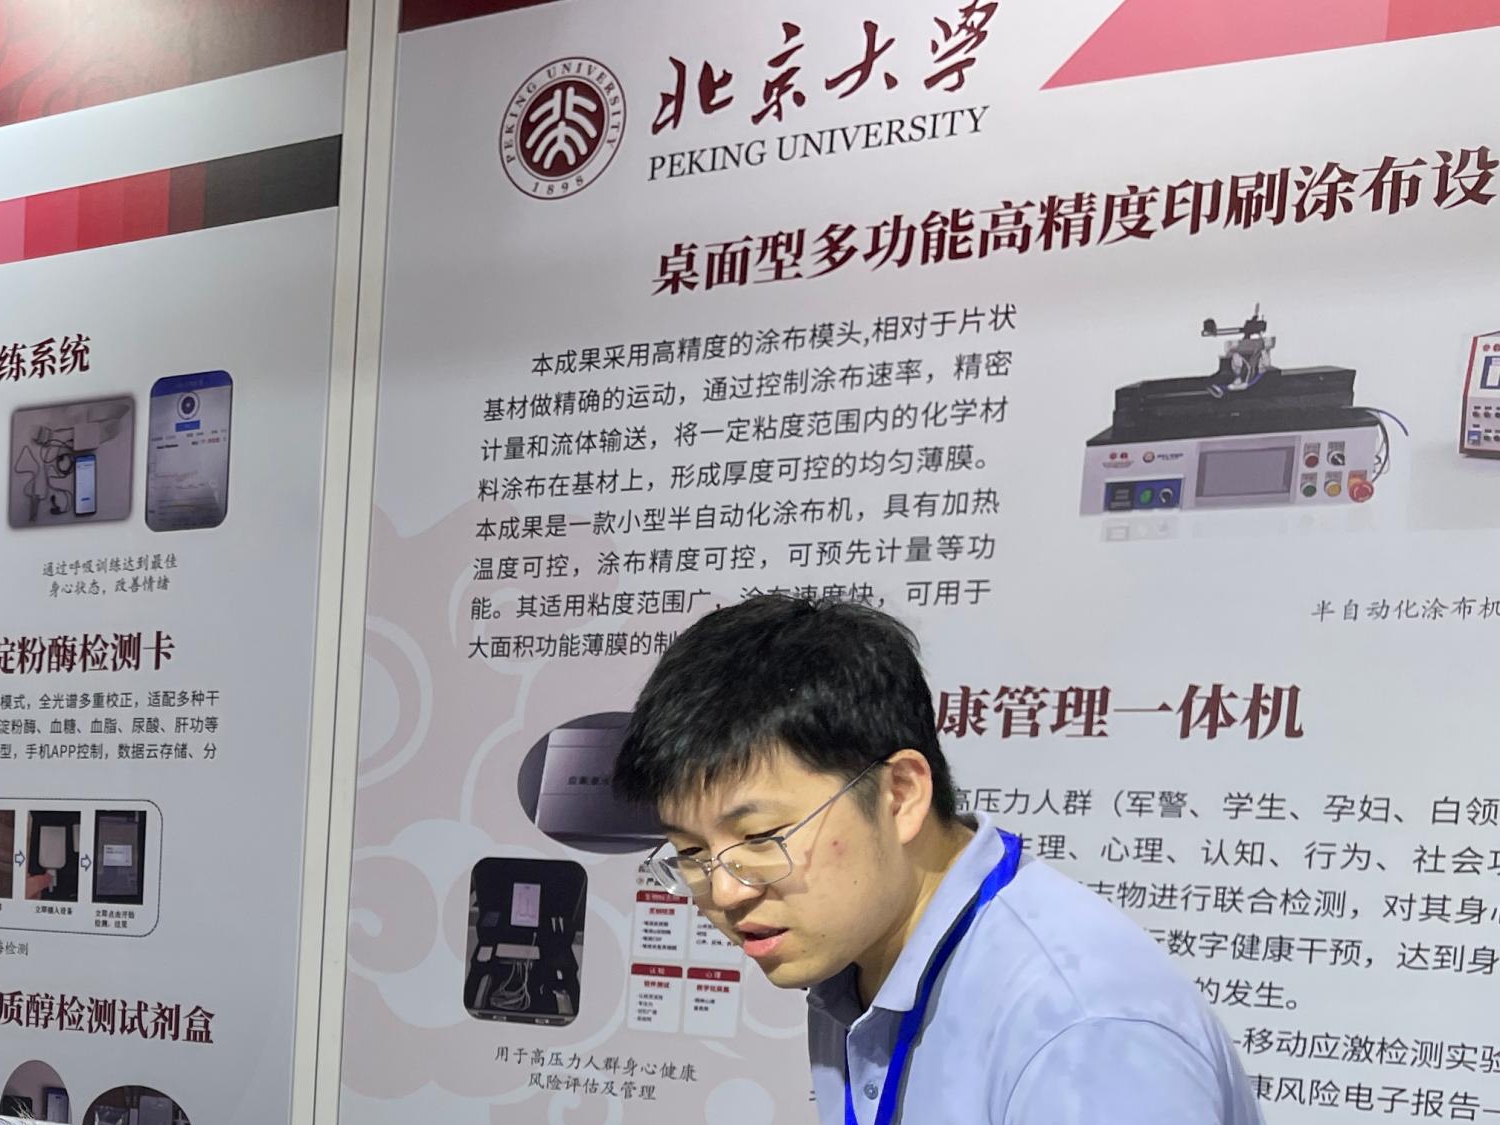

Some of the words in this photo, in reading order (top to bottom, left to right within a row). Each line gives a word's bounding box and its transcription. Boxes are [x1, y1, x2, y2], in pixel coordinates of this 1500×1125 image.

[647, 140, 768, 182] PEKING
[777, 105, 991, 161] UNIVERSITY
[531, 175, 584, 195] 1898
[651, 145, 1499, 297] 桌面型多功能高精度印刷涂布设
[1087, 881, 1500, 926] 物进行联合检测，对其身
[494, 1045, 698, 1083] 用于高压力人群身心健康
[528, 1071, 656, 1101] 风险评估及管理
